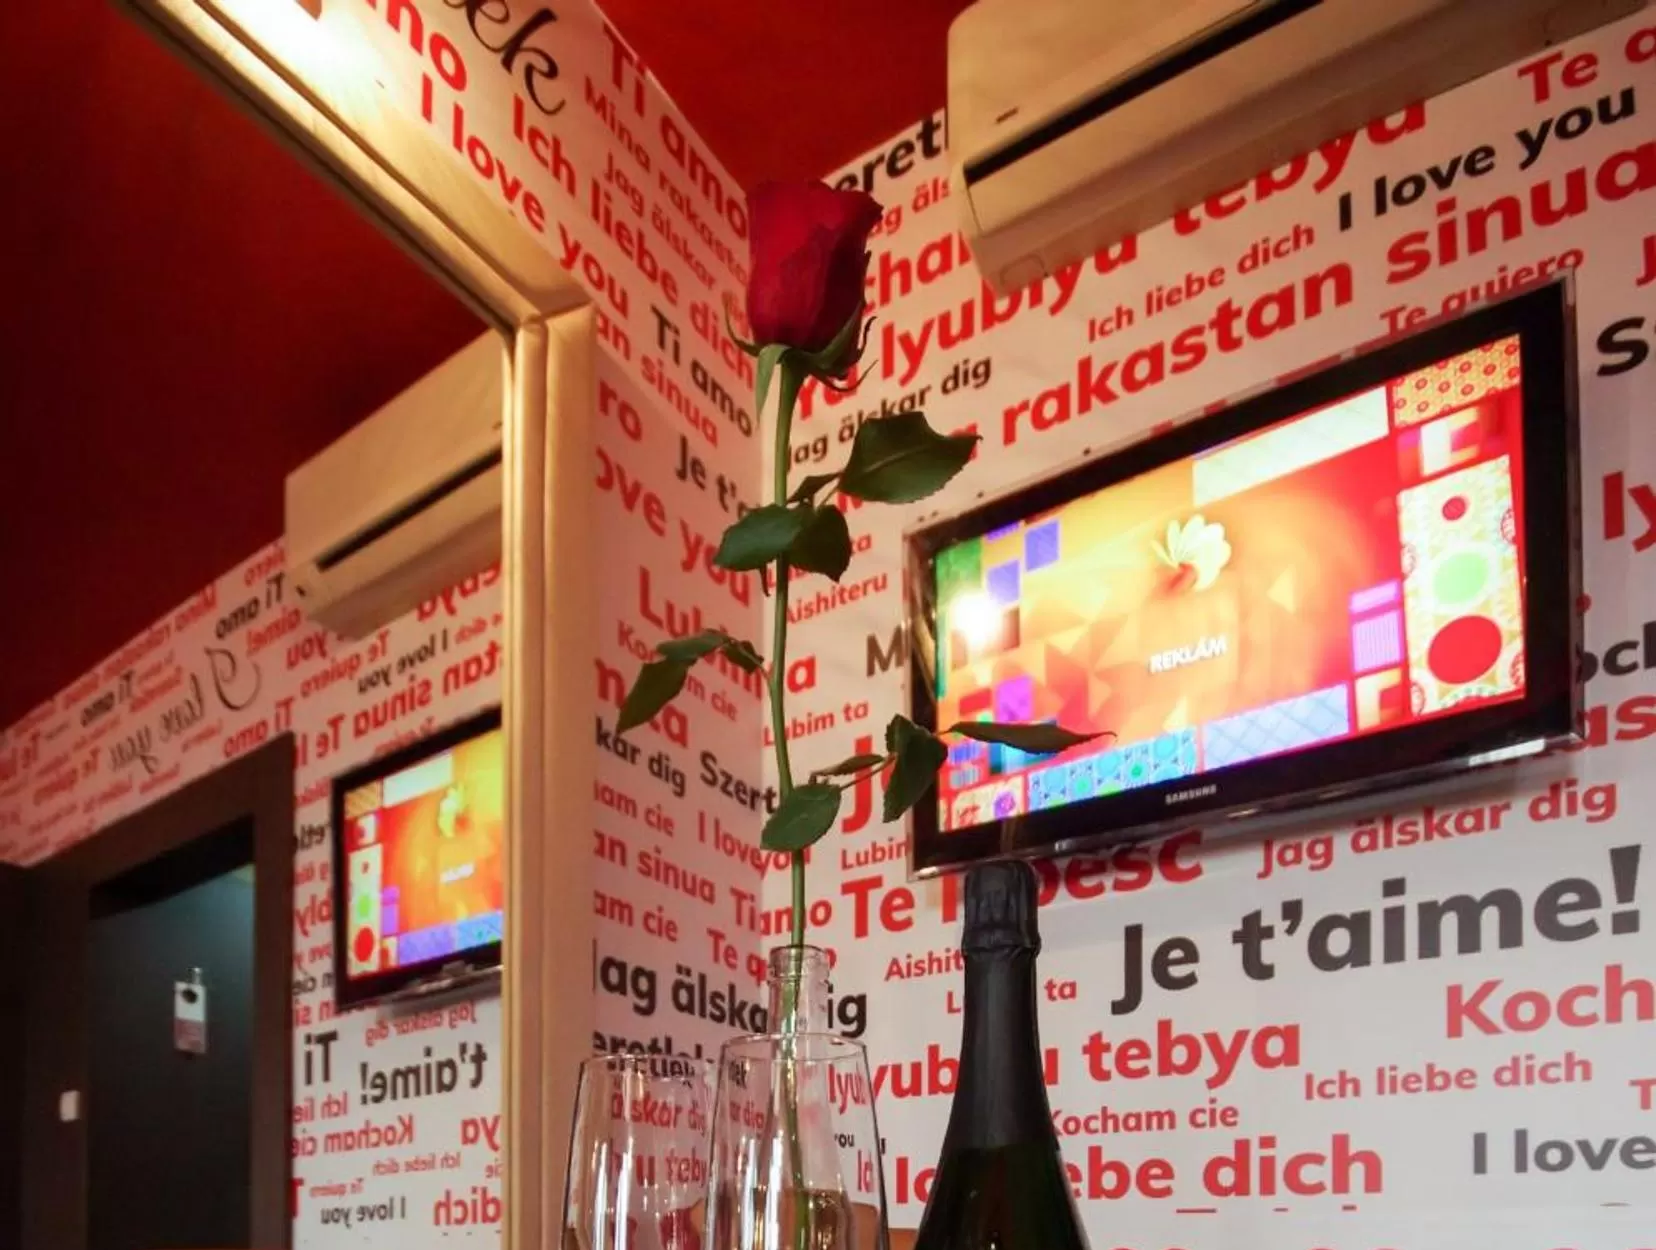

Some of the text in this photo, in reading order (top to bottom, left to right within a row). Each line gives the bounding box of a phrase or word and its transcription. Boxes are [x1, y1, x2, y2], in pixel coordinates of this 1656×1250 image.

[1517, 50, 1598, 104] Te
[1337, 86, 1637, 233] I love you
[421, 72, 630, 321] I love you
[513, 92, 755, 392] Ich liebe dich
[1002, 140, 1656, 448] rakastan sinua
[1089, 223, 1316, 344] Ich liebe dich
[640, 354, 719, 448] sinua
[651, 303, 753, 439] Ti amo
[940, 358, 992, 396] dig
[675, 432, 706, 492] Je
[842, 700, 870, 724] ta
[647, 750, 686, 798] dig
[644, 803, 676, 839] cie
[698, 809, 706, 845] I
[1256, 777, 1618, 880] Jag älskar dig
[636, 845, 715, 906] sinua
[729, 886, 757, 932] Ti
[840, 875, 916, 939] Te
[642, 904, 679, 943] cie
[706, 927, 739, 971] Te
[1110, 843, 1642, 1016] Je t'aime!
[671, 962, 768, 1034] älska
[883, 948, 965, 984] Aishit
[1043, 978, 1078, 1003] ta
[1445, 963, 1656, 1040] Koch
[1081, 1018, 1301, 1091] tebya
[1304, 1050, 1593, 1101] Ich liebe dich
[1188, 1097, 1240, 1129] cie
[1202, 1132, 1384, 1198] dich
[1473, 1127, 1656, 1175] I love
